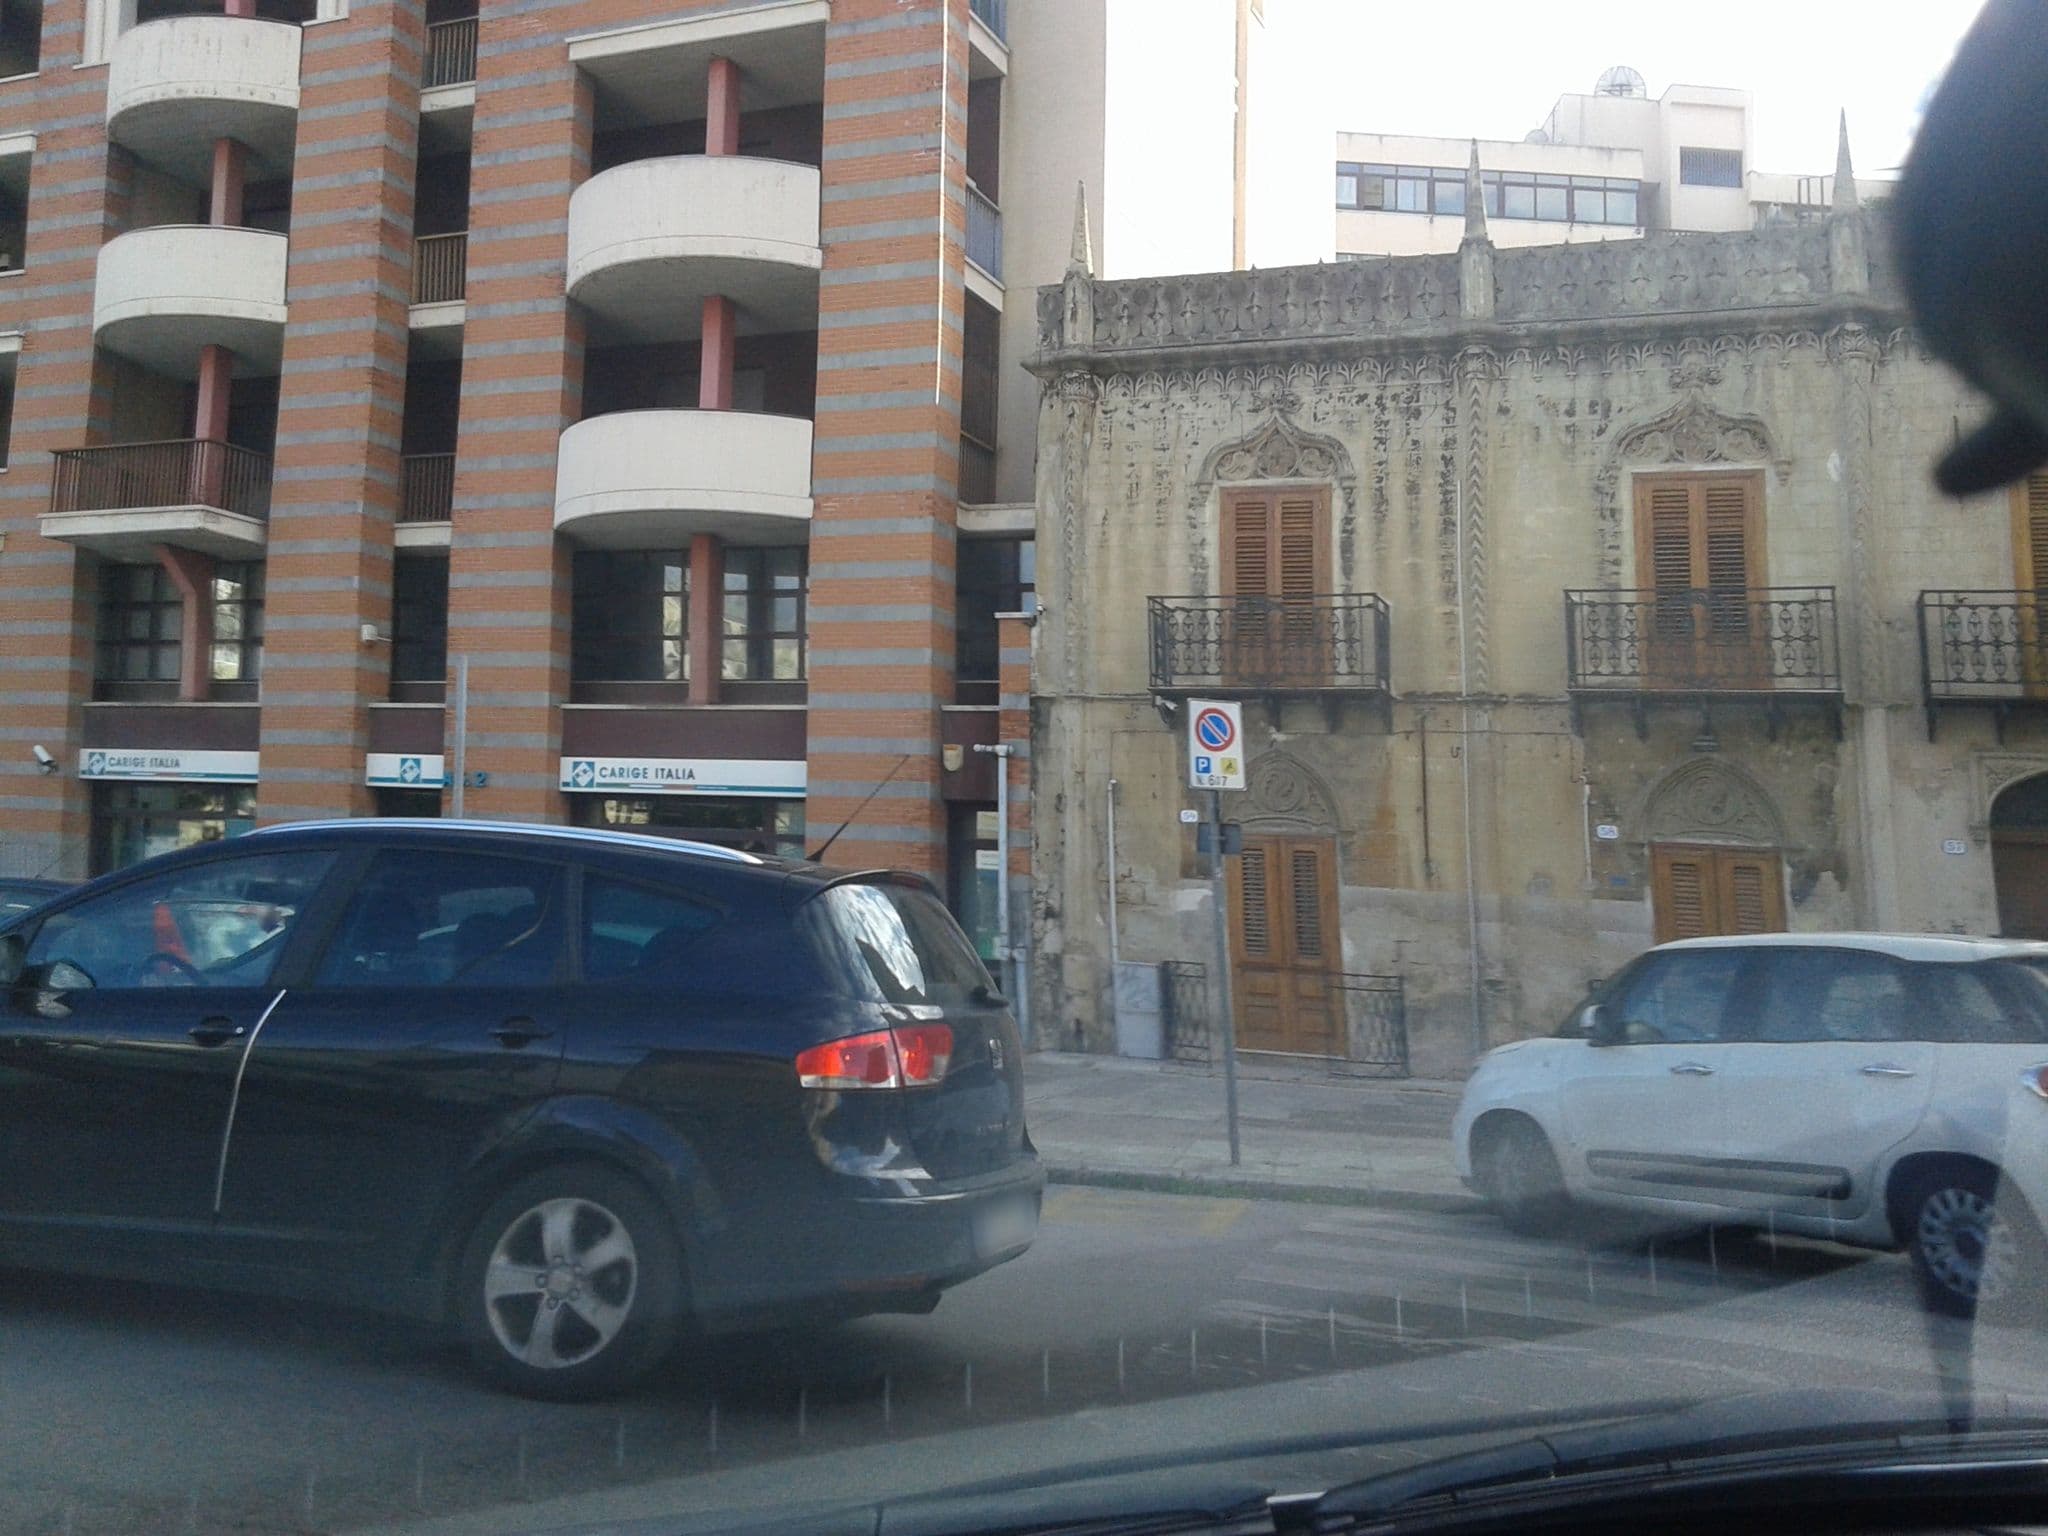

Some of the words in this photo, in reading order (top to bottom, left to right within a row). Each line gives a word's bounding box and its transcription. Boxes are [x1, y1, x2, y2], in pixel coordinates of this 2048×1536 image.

[108, 757, 146, 768] CARIGE
[149, 758, 180, 768] ITALIA
[599, 766, 648, 779] CARIGE
[655, 768, 696, 780] ITALIA
